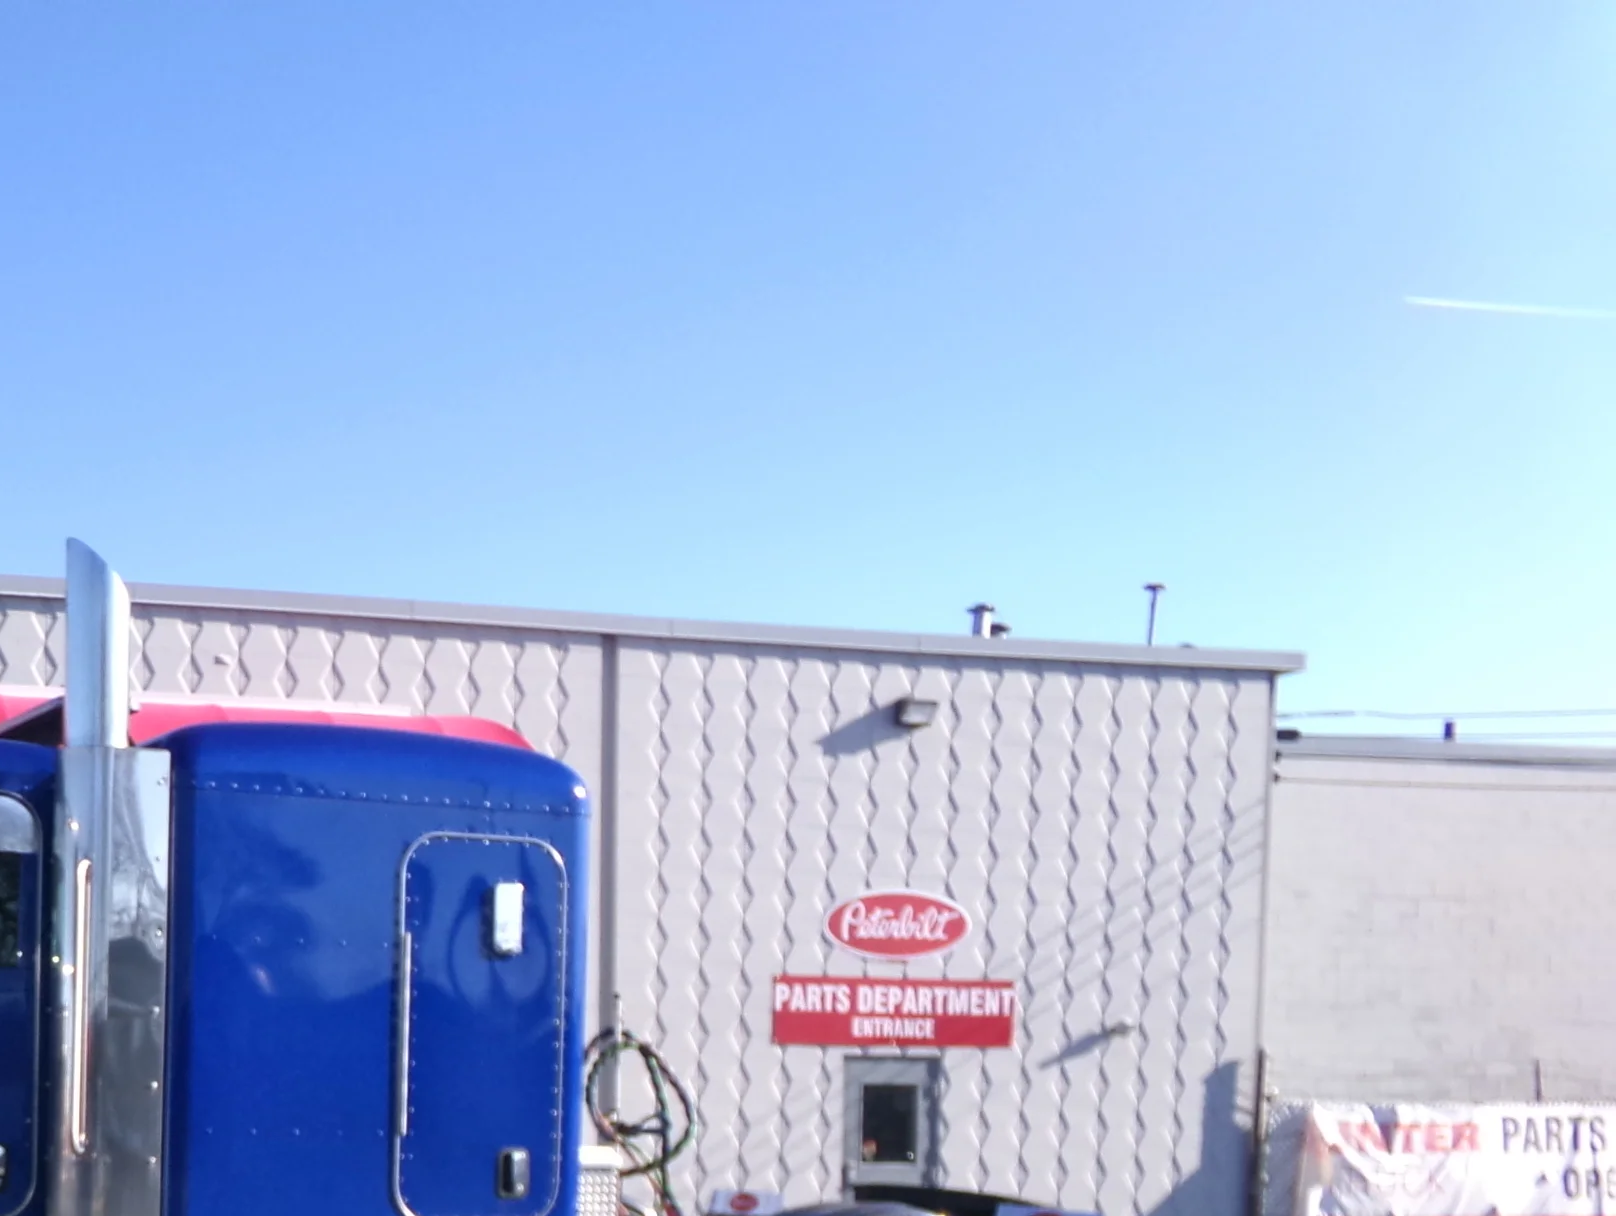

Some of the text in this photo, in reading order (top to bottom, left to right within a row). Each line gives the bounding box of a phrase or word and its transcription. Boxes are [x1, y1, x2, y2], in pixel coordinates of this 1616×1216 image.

[839, 899, 960, 942] Peterbilt
[775, 982, 1017, 1017] PARTS DEPARTMENT
[851, 1016, 935, 1040] ENTRANCE
[1501, 1115, 1606, 1154] PARTS
